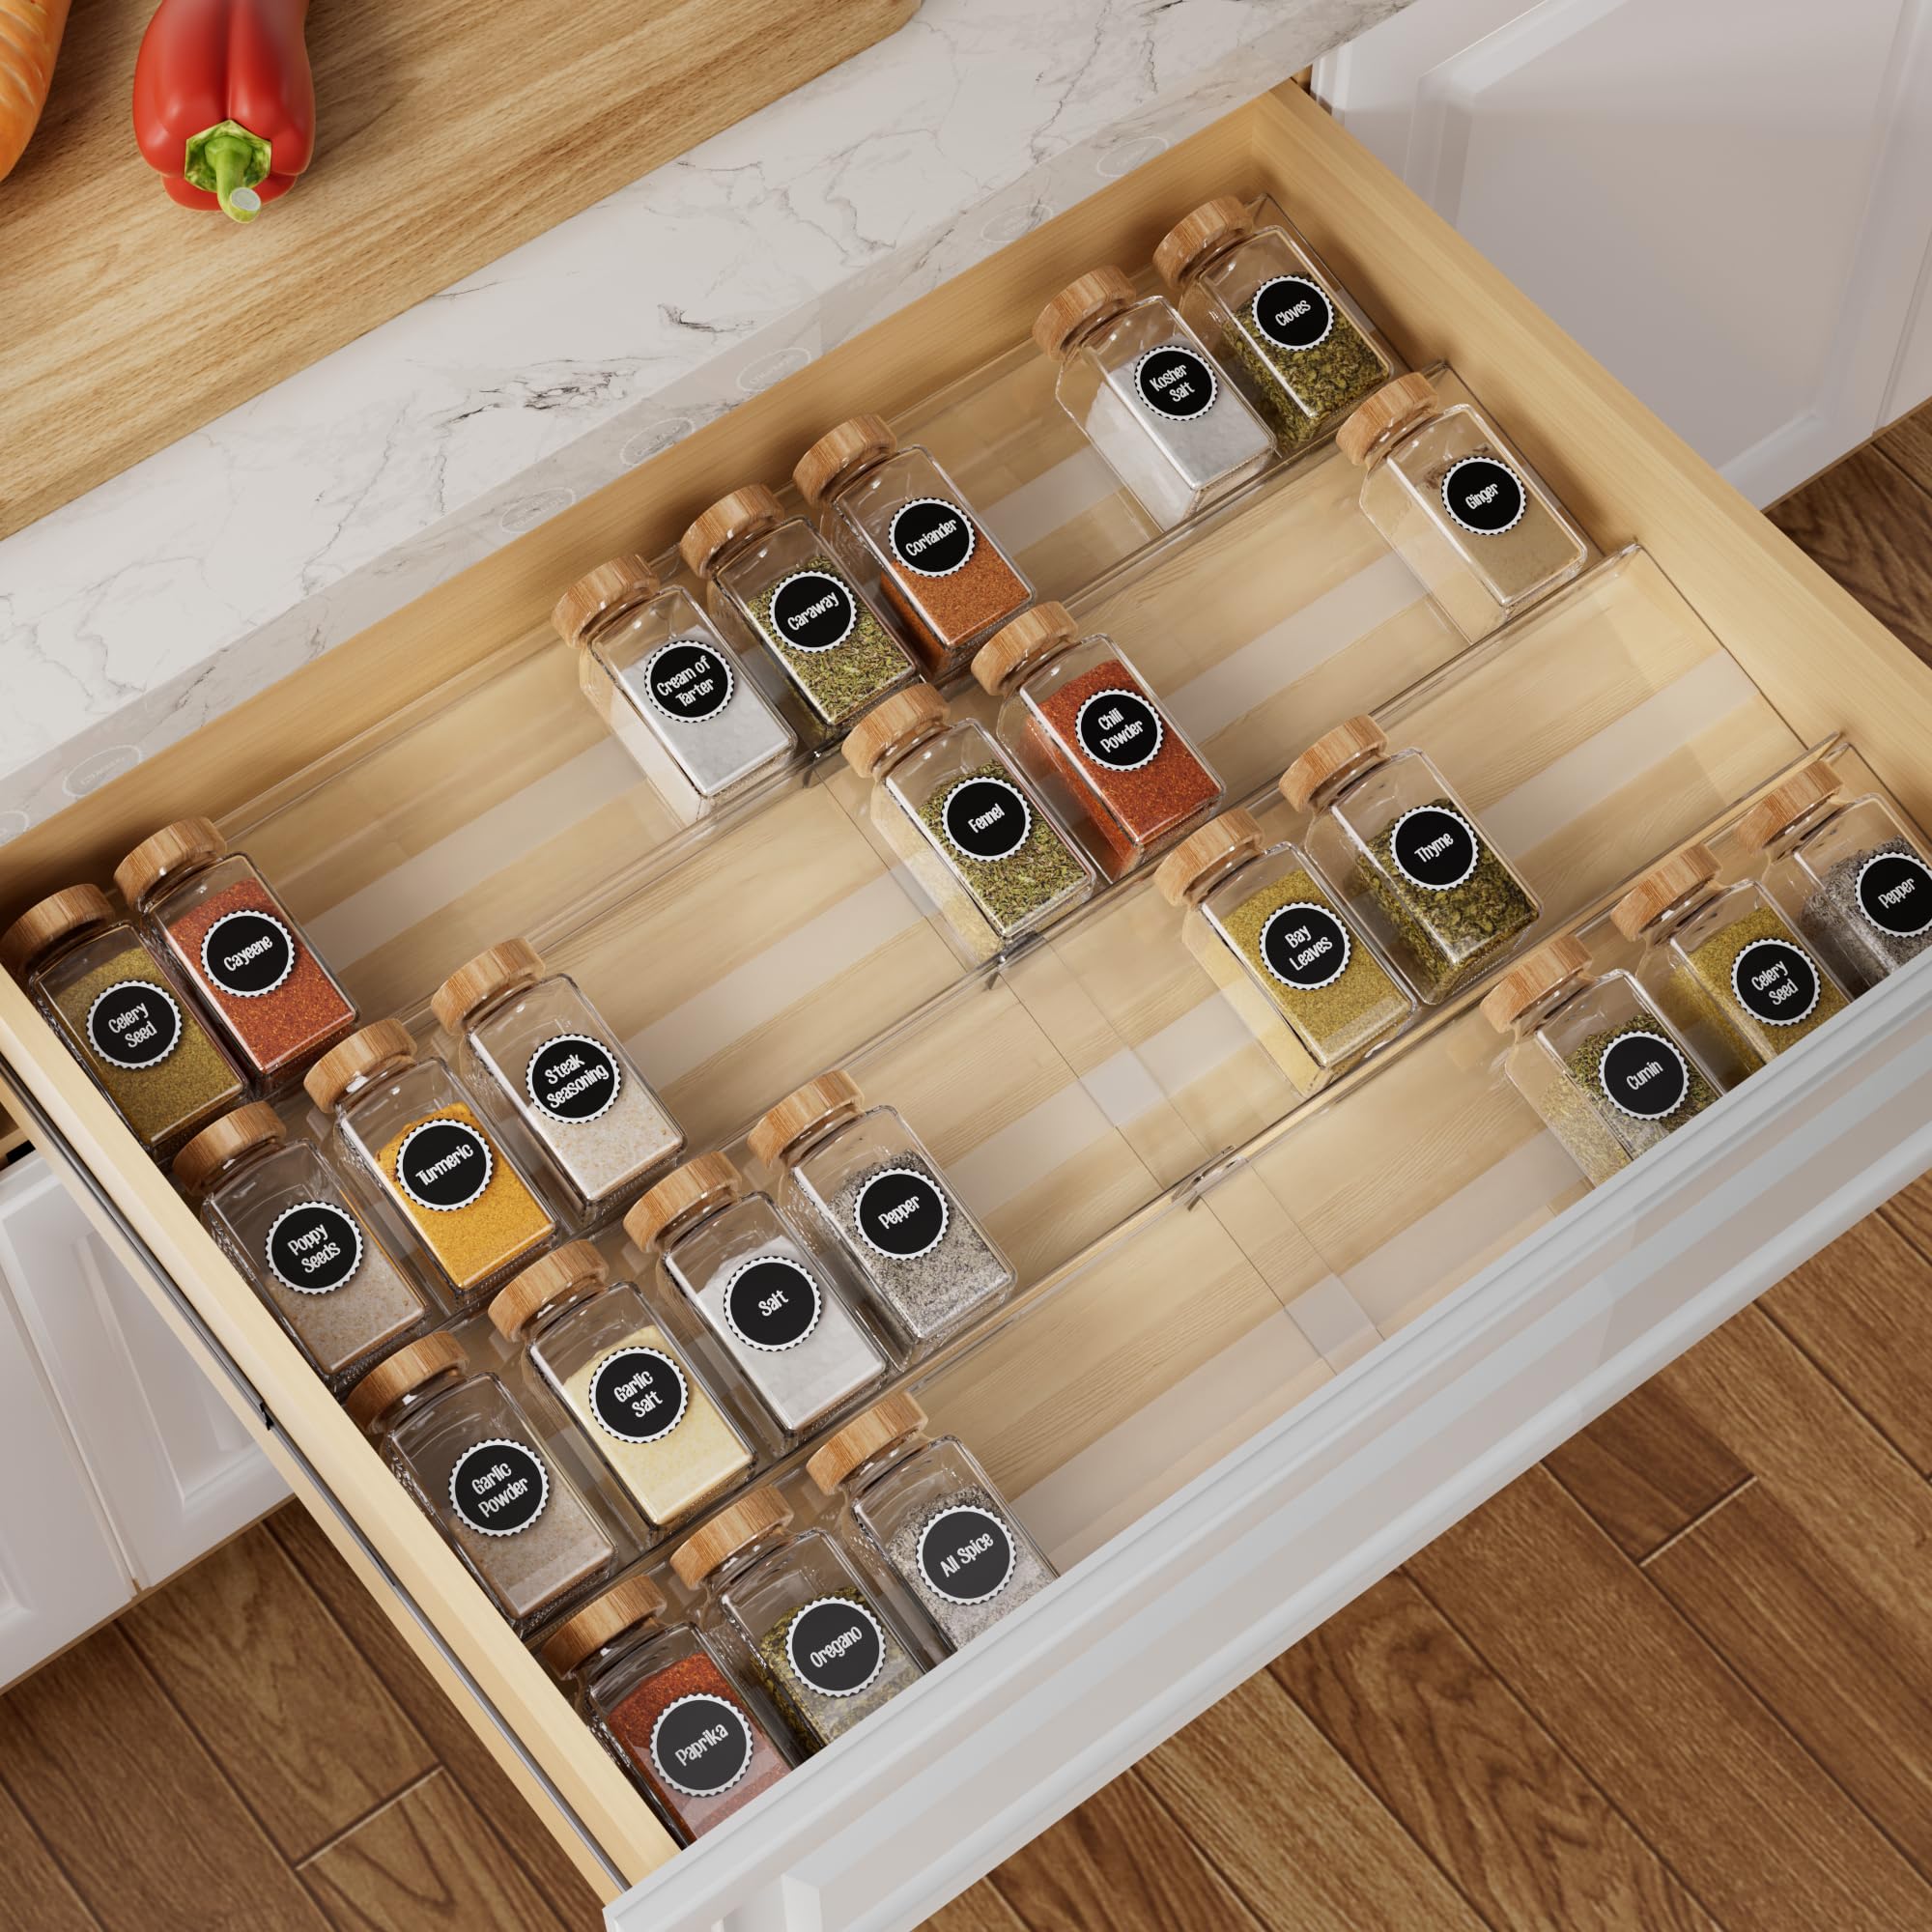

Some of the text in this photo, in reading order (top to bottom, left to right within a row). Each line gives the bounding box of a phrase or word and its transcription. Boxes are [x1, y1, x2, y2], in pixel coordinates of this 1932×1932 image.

[1274, 299, 1311, 327] Cloves
[1149, 364, 1187, 392] Kosher
[1169, 382, 1195, 402] Salt
[1464, 483, 1499, 510] Ginger
[905, 519, 957, 556] Coriander
[787, 591, 839, 631] Caraway
[656, 655, 711, 696] Cream of
[674, 678, 714, 707] Tarter
[1097, 707, 1124, 730] Chili
[1099, 720, 1144, 753] Powder
[967, 803, 1006, 834] Fennel
[1413, 833, 1454, 863] Thyme
[1877, 878, 1916, 909] Pepper
[1284, 924, 1312, 949] Bay
[223, 935, 273, 972] Cayeene
[1289, 936, 1333, 971] Leaves
[1750, 960, 1789, 991] Celery
[1768, 978, 1799, 1006] Seed
[108, 1002, 149, 1034] Celery
[125, 1020, 157, 1048] Seed
[544, 1054, 585, 1085] Steak
[1626, 1061, 1663, 1091] Cumin
[546, 1064, 610, 1109] Seasoning
[414, 1144, 474, 1186] Turmeric
[877, 1195, 921, 1230] Pepper
[287, 1224, 328, 1256] Poppy
[300, 1241, 341, 1273] Seeds
[757, 1290, 789, 1317] Salt
[613, 1371, 654, 1403] Garlic
[631, 1390, 664, 1418] Salt
[471, 1463, 512, 1495] Garlic
[477, 1477, 528, 1519] Powder
[940, 1532, 994, 1578] All Spice
[810, 1626, 863, 1668] Oregano
[674, 1723, 729, 1767] Paprika
